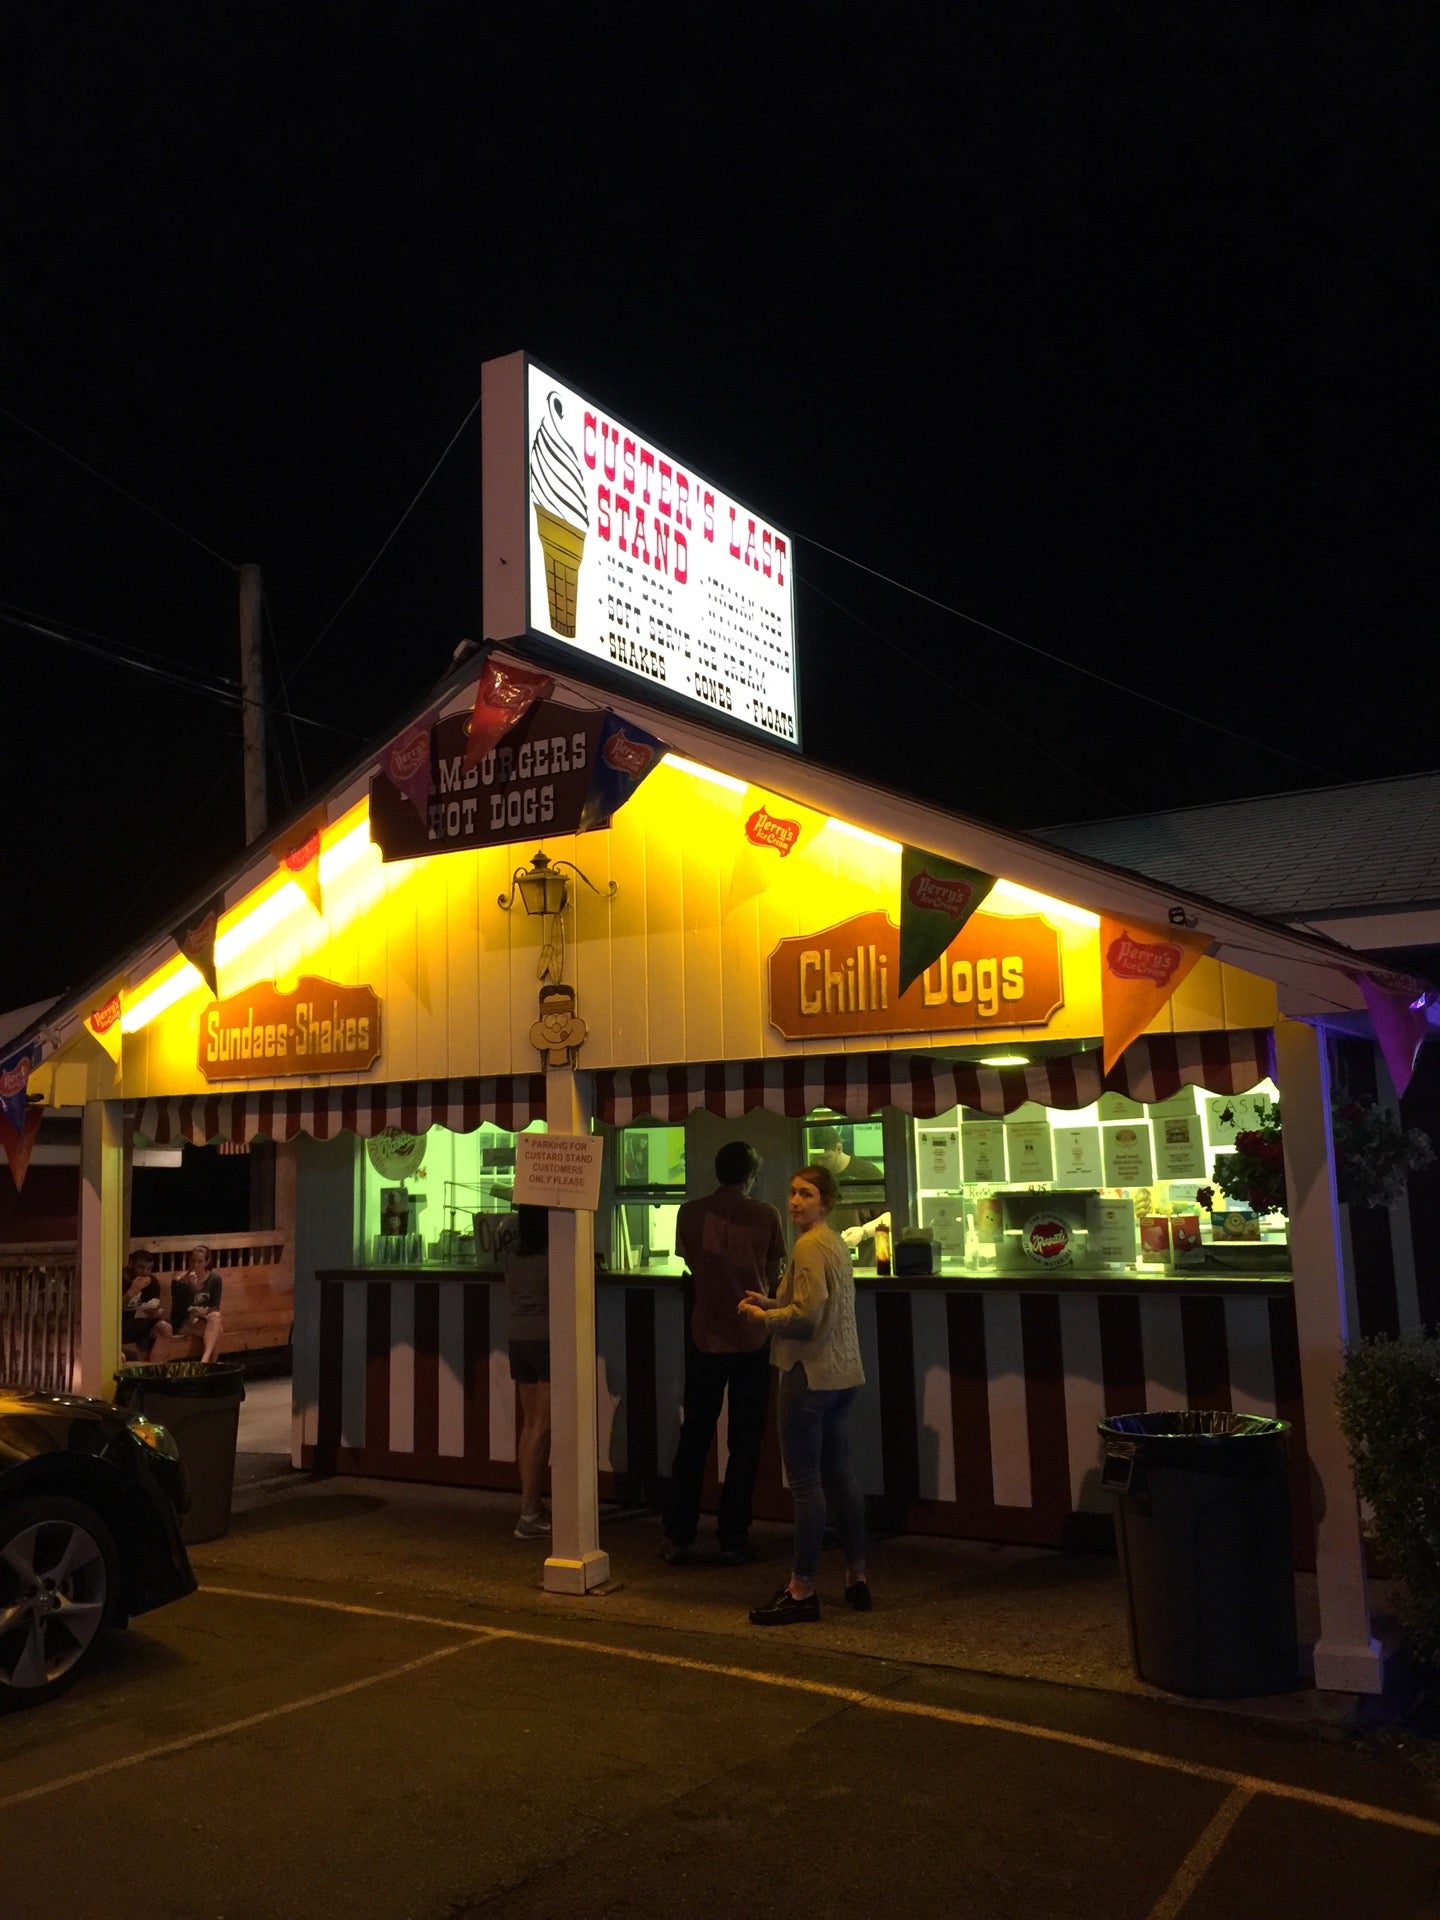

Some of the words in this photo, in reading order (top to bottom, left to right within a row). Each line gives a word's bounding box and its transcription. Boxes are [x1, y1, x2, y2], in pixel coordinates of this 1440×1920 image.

[584, 411, 715, 543] CUSTER'S
[729, 506, 787, 587] LAST
[597, 483, 688, 585] STAND
[607, 594, 641, 634] SOFT
[649, 615, 692, 659] SERVE
[609, 631, 666, 681] SHAKES
[694, 671, 733, 712] CONES
[752, 698, 794, 738] FLOATS
[400, 732, 586, 799] MBURGERS
[428, 798, 477, 840] HOT
[490, 784, 554, 831] DOGS
[753, 813, 794, 842] Perry's
[917, 876, 964, 904] Perry's
[1117, 941, 1172, 969] Perry's
[800, 944, 888, 1015] Chilli
[207, 1008, 287, 1062] Sundaes
[295, 1000, 370, 1056] Shakes
[525, 1151, 563, 1161] CUSTARD
[566, 1154, 593, 1164] STAND
[532, 1140, 568, 1151] PARKING
[570, 1143, 588, 1152] FOR
[529, 1174, 552, 1185] ONLY
[553, 1176, 585, 1187] PLEASE
[532, 1162, 584, 1175] CUSTOMERS
